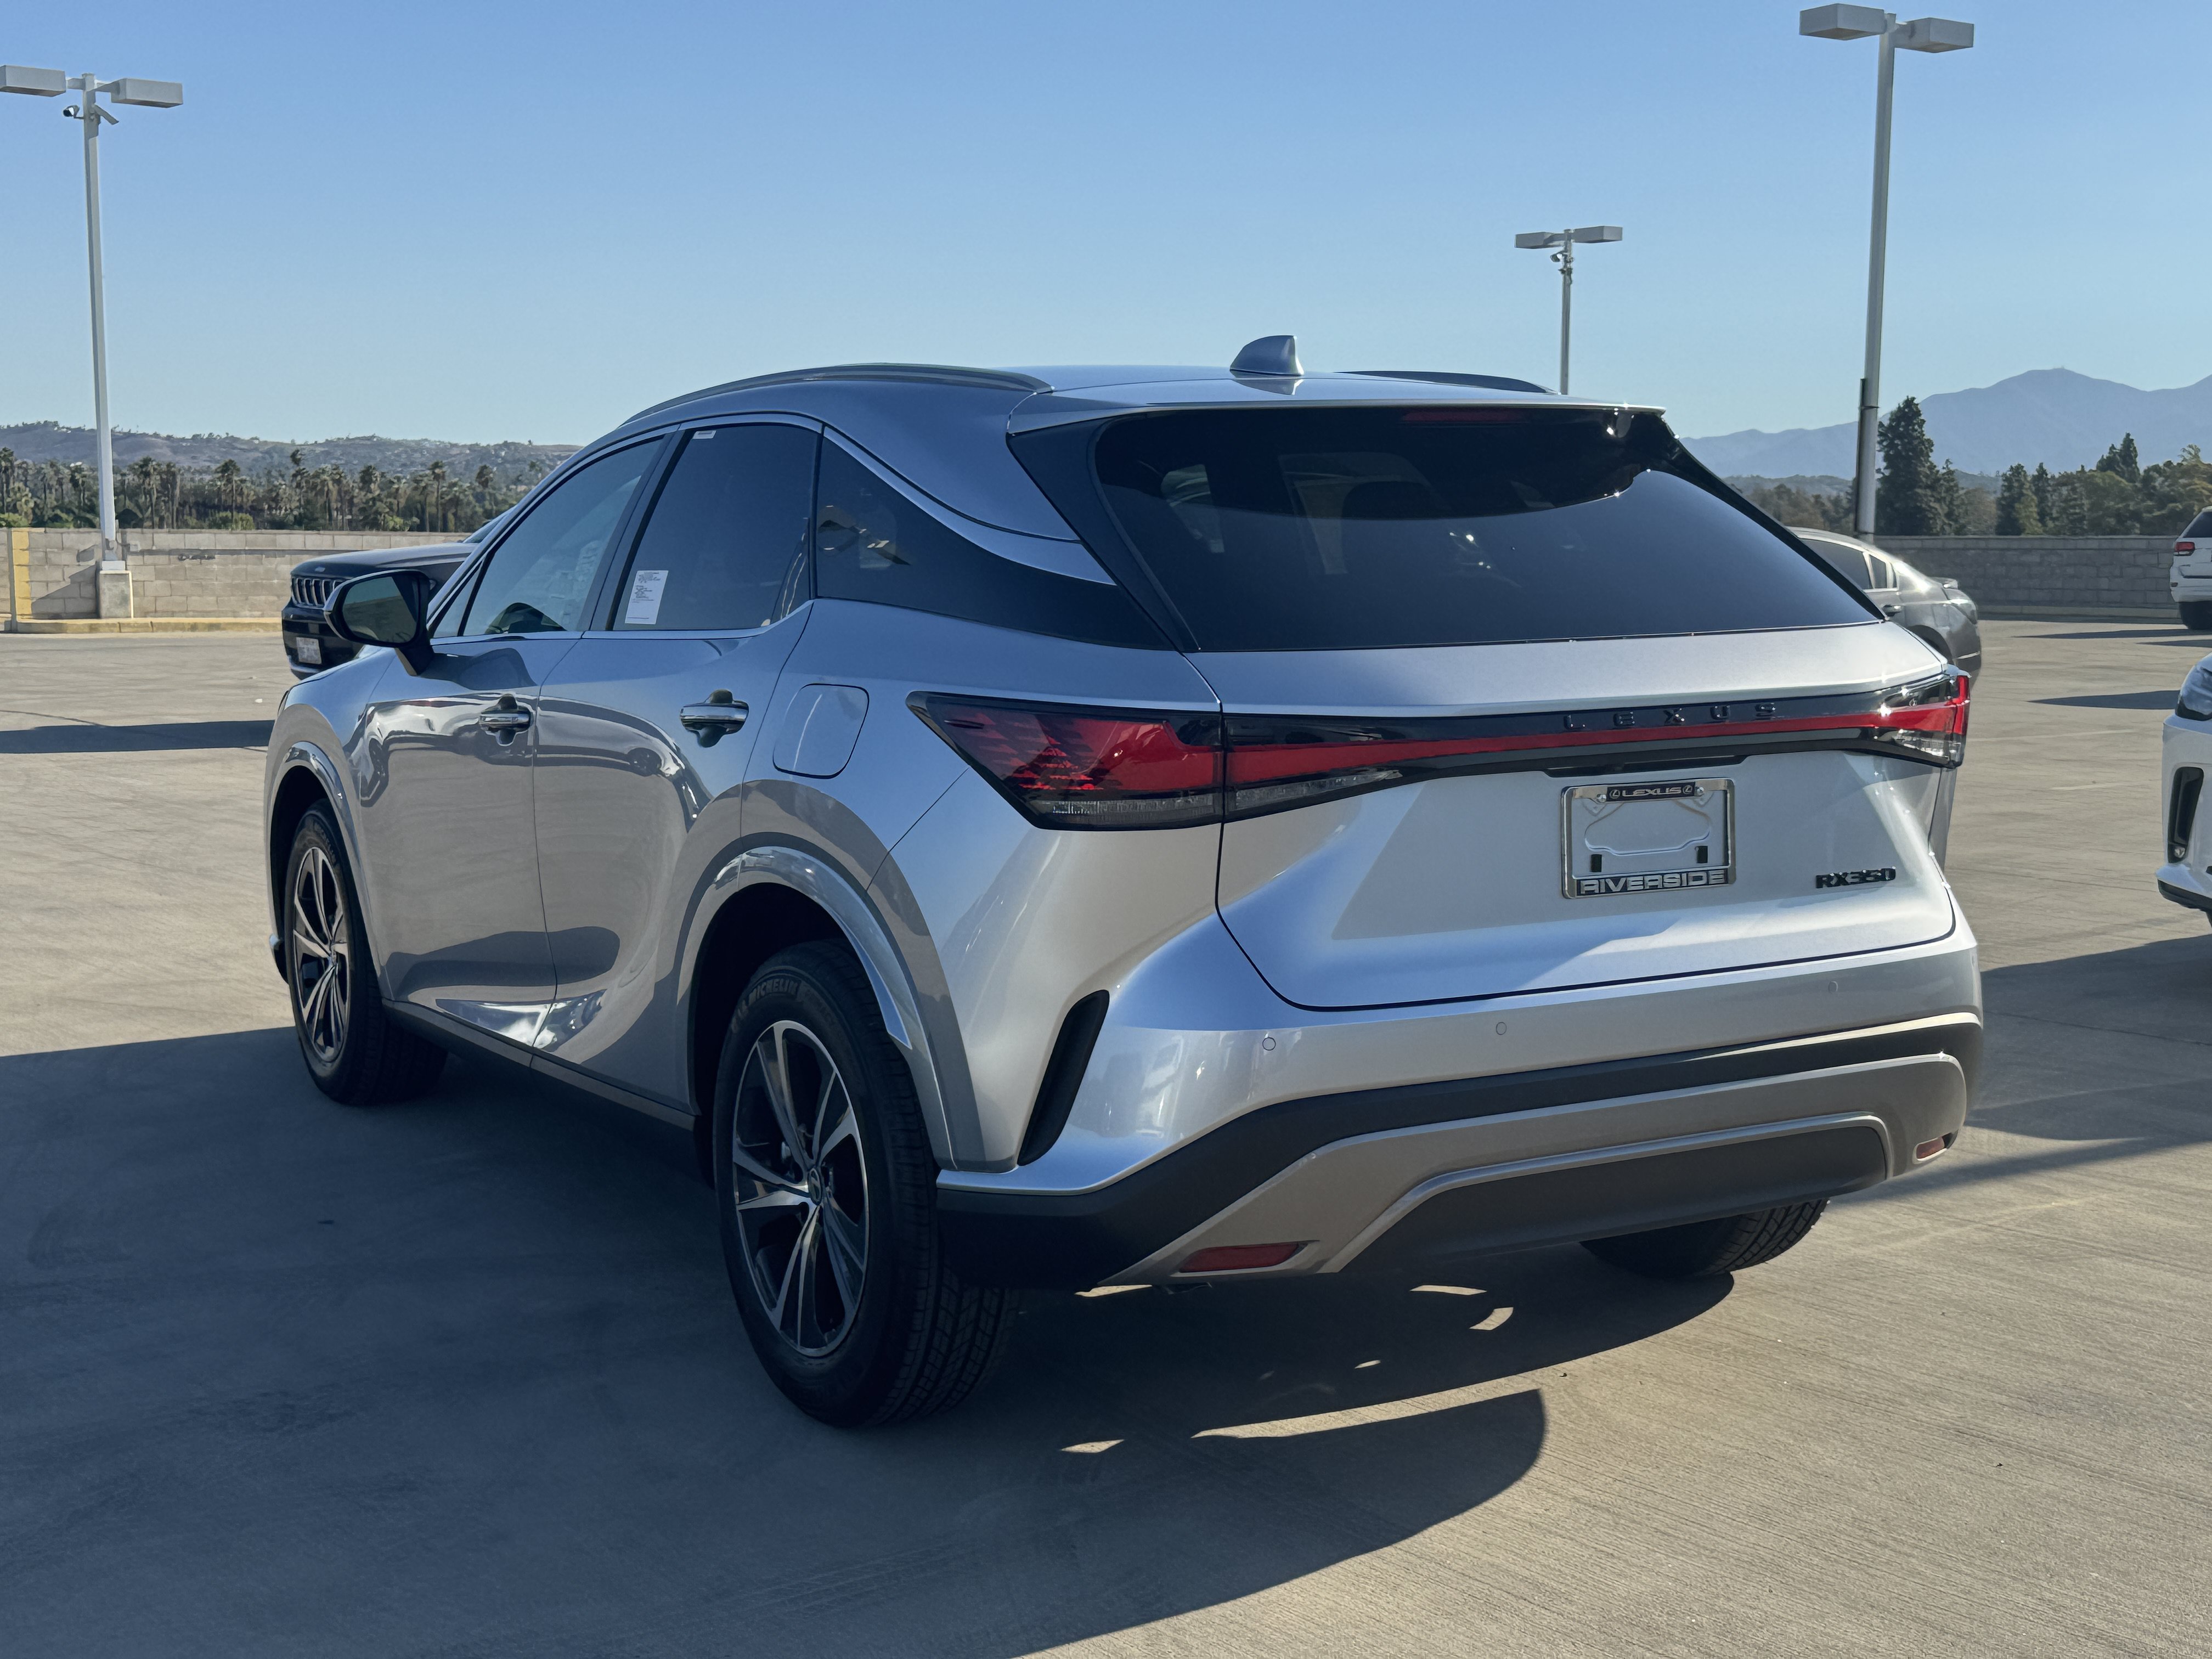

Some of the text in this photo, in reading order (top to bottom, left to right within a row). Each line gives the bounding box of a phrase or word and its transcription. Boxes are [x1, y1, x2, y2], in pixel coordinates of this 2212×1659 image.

[1563, 702, 1776, 730] LEXUS
[1622, 786, 1682, 797] LEXUS
[1580, 870, 1725, 894] RIVERSIDE
